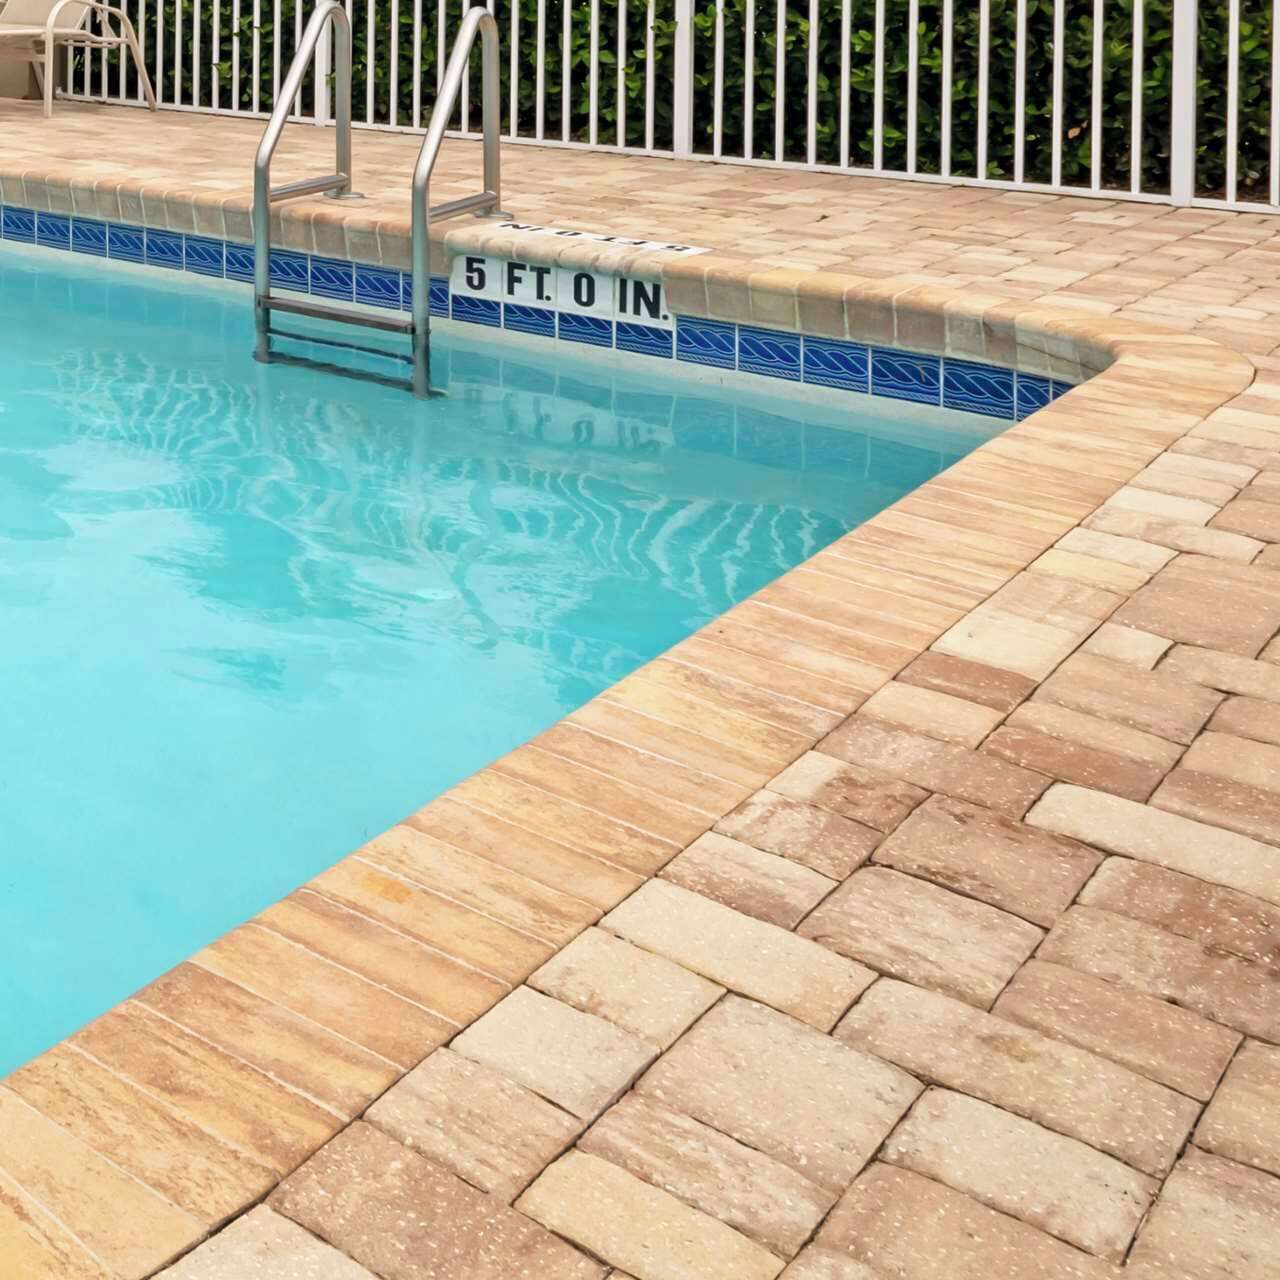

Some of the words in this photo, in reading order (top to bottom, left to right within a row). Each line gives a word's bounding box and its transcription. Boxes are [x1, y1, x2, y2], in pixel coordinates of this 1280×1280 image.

[466, 256, 486, 291] 5
[507, 261, 552, 302] FT.
[573, 272, 595, 308] 0
[619, 278, 669, 321] IN.
